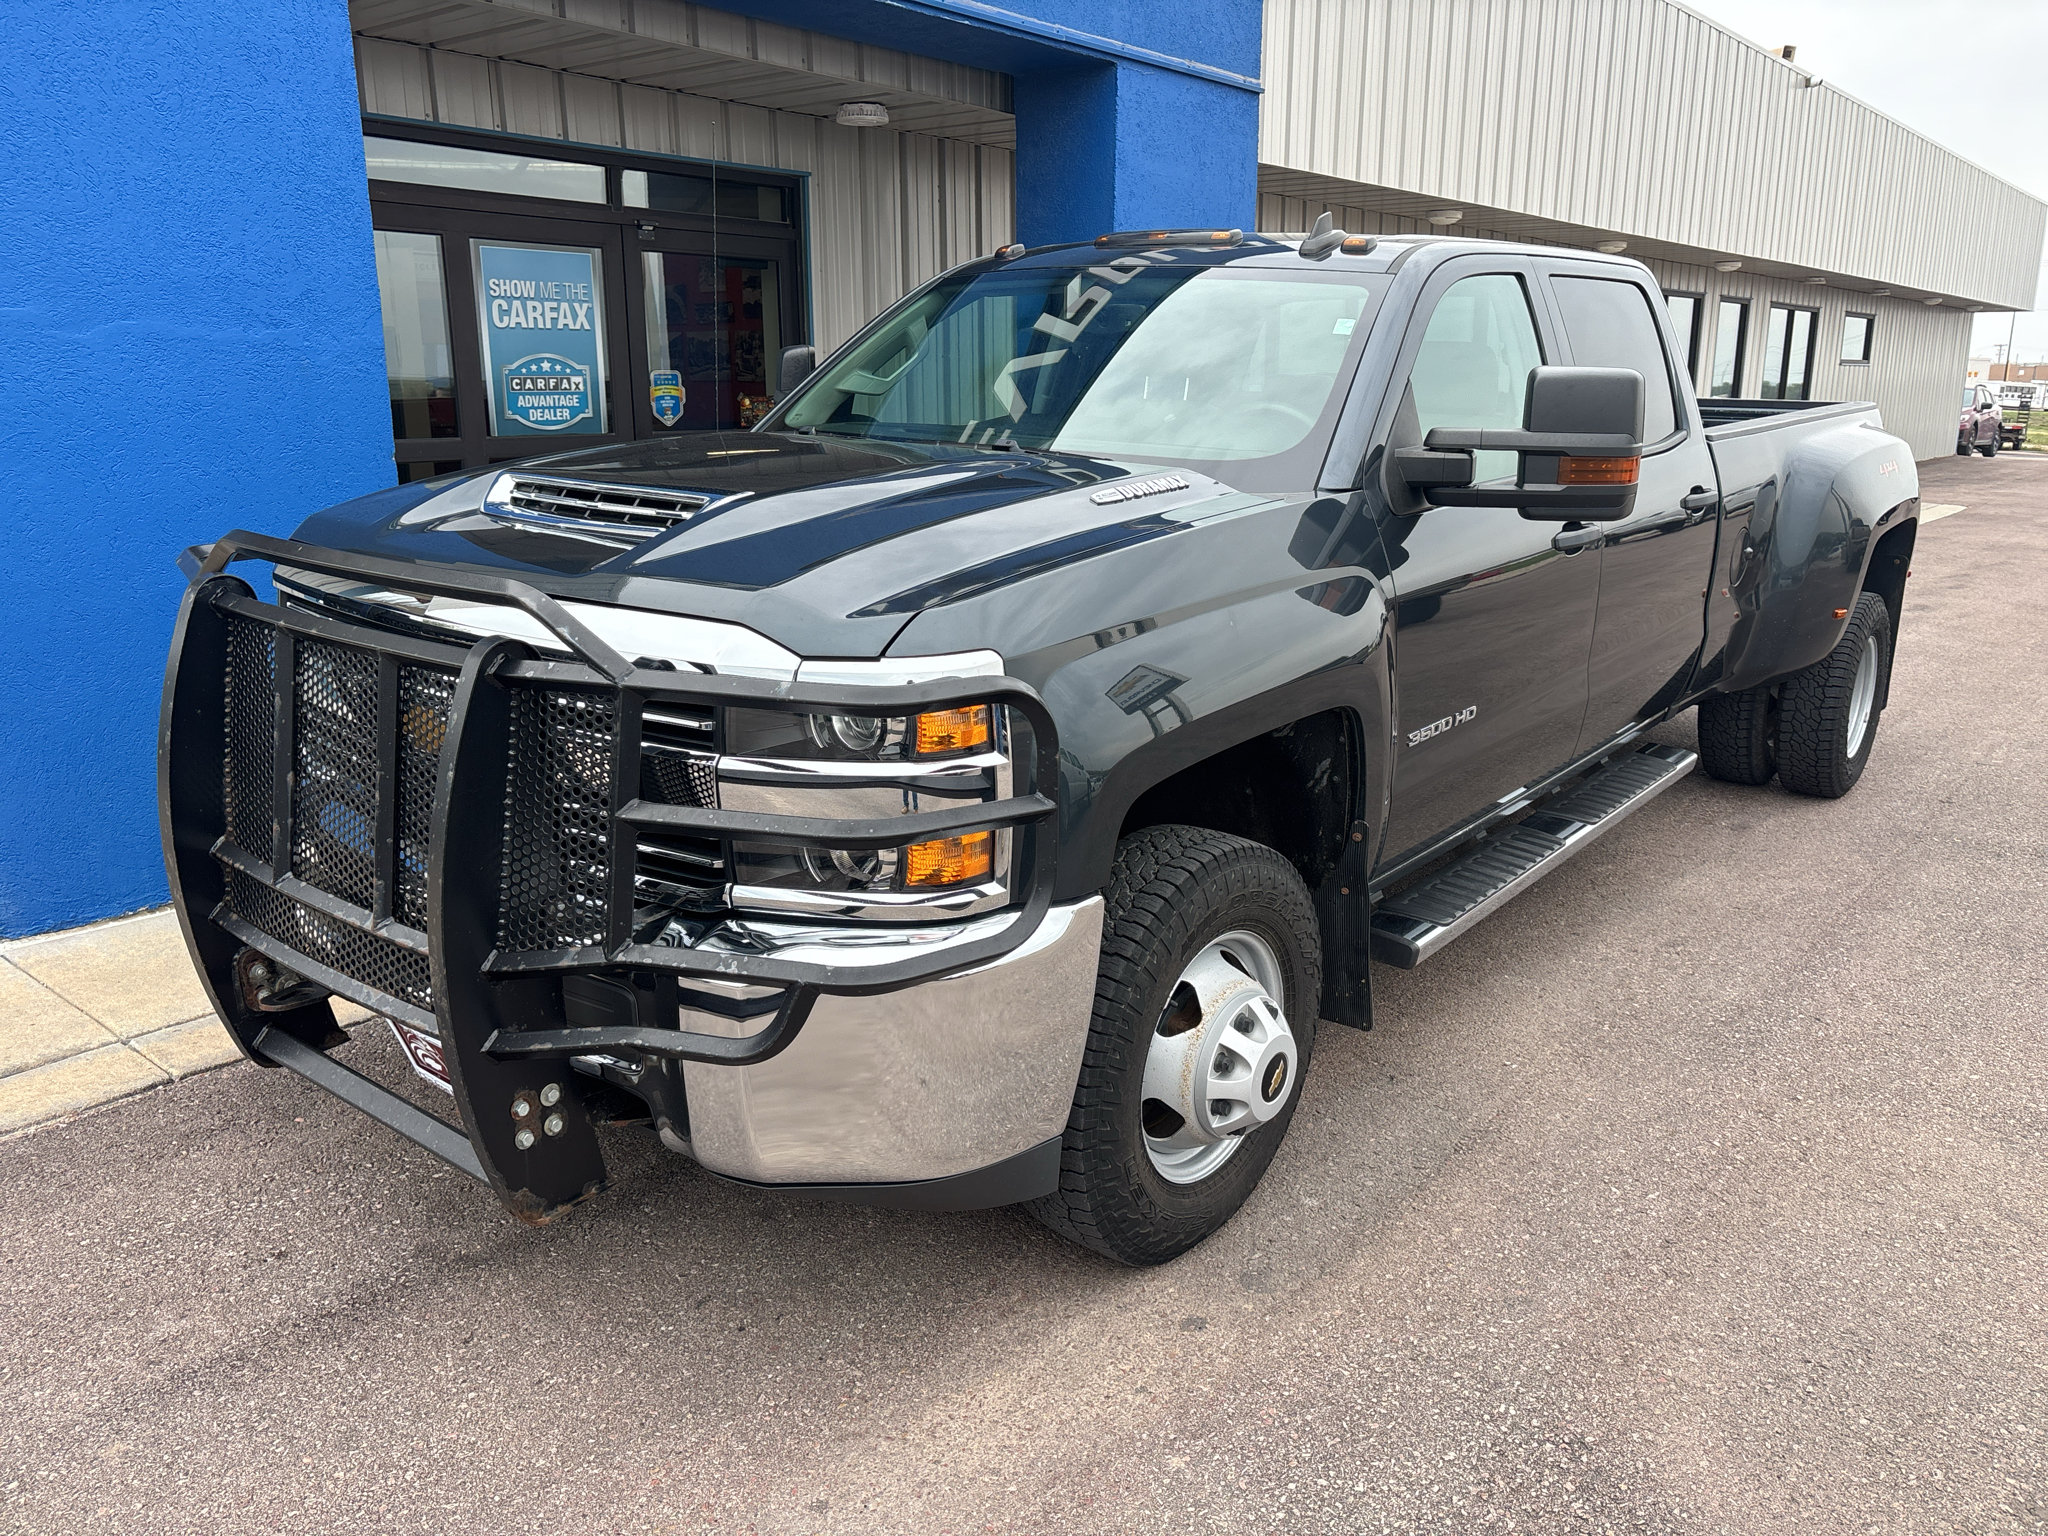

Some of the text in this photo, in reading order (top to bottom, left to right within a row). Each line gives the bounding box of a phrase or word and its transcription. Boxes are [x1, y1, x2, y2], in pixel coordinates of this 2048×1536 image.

[488, 278, 589, 301] SHOW ME THE
[491, 299, 592, 330] CARFAX
[511, 377, 583, 391] CARFAX
[517, 394, 581, 408] ADVANTAGE
[528, 408, 571, 421] DEALER
[1114, 475, 1190, 501] DURAMAX
[1406, 705, 1477, 748] 3500 HD
